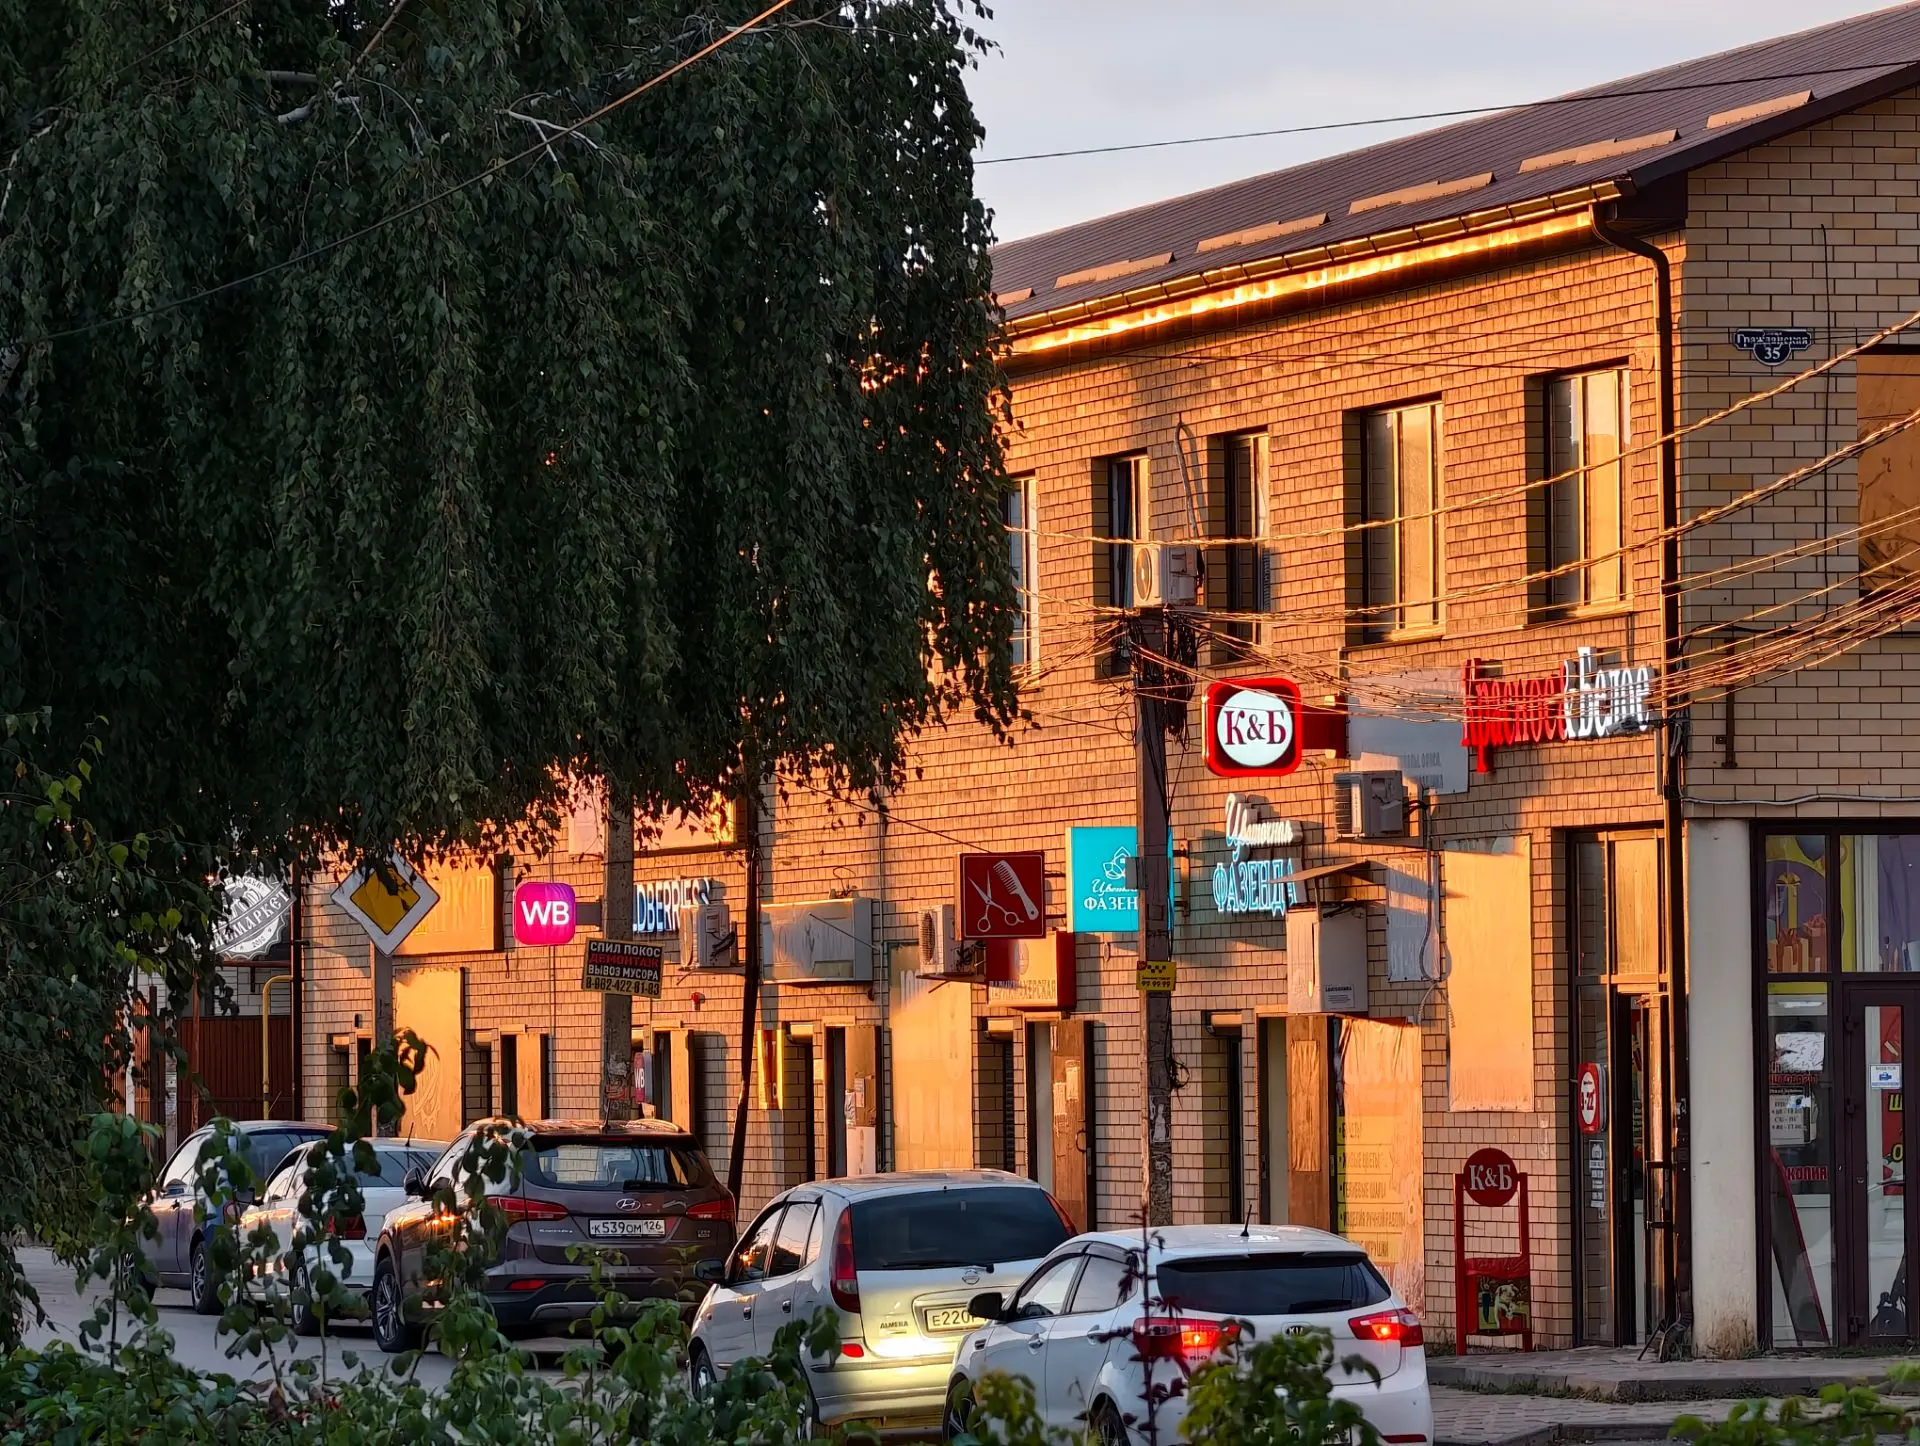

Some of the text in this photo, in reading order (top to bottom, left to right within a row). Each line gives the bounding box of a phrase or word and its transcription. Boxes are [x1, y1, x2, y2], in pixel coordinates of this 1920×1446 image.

[1736, 333, 1808, 347] Гражданская
[1764, 347, 1781, 360] 35
[1225, 710, 1287, 745] К&Б
[1225, 793, 1295, 862] Цветочная
[1212, 859, 1298, 918] ФАЗЕНДА
[1084, 896, 1139, 911] ФАЗЕН
[521, 900, 570, 926] WB
[590, 942, 661, 958] СПИЛ ПОКОС
[588, 952, 659, 969] ДЕМОНТАЖ
[588, 964, 659, 981] ВЫВОЗ МУСОРА
[633, 1067, 645, 1089] WB
[1468, 1163, 1513, 1191] К&Б
[1786, 1166, 1828, 1181] КОПИЯ
[643, 1220, 662, 1231] 126
